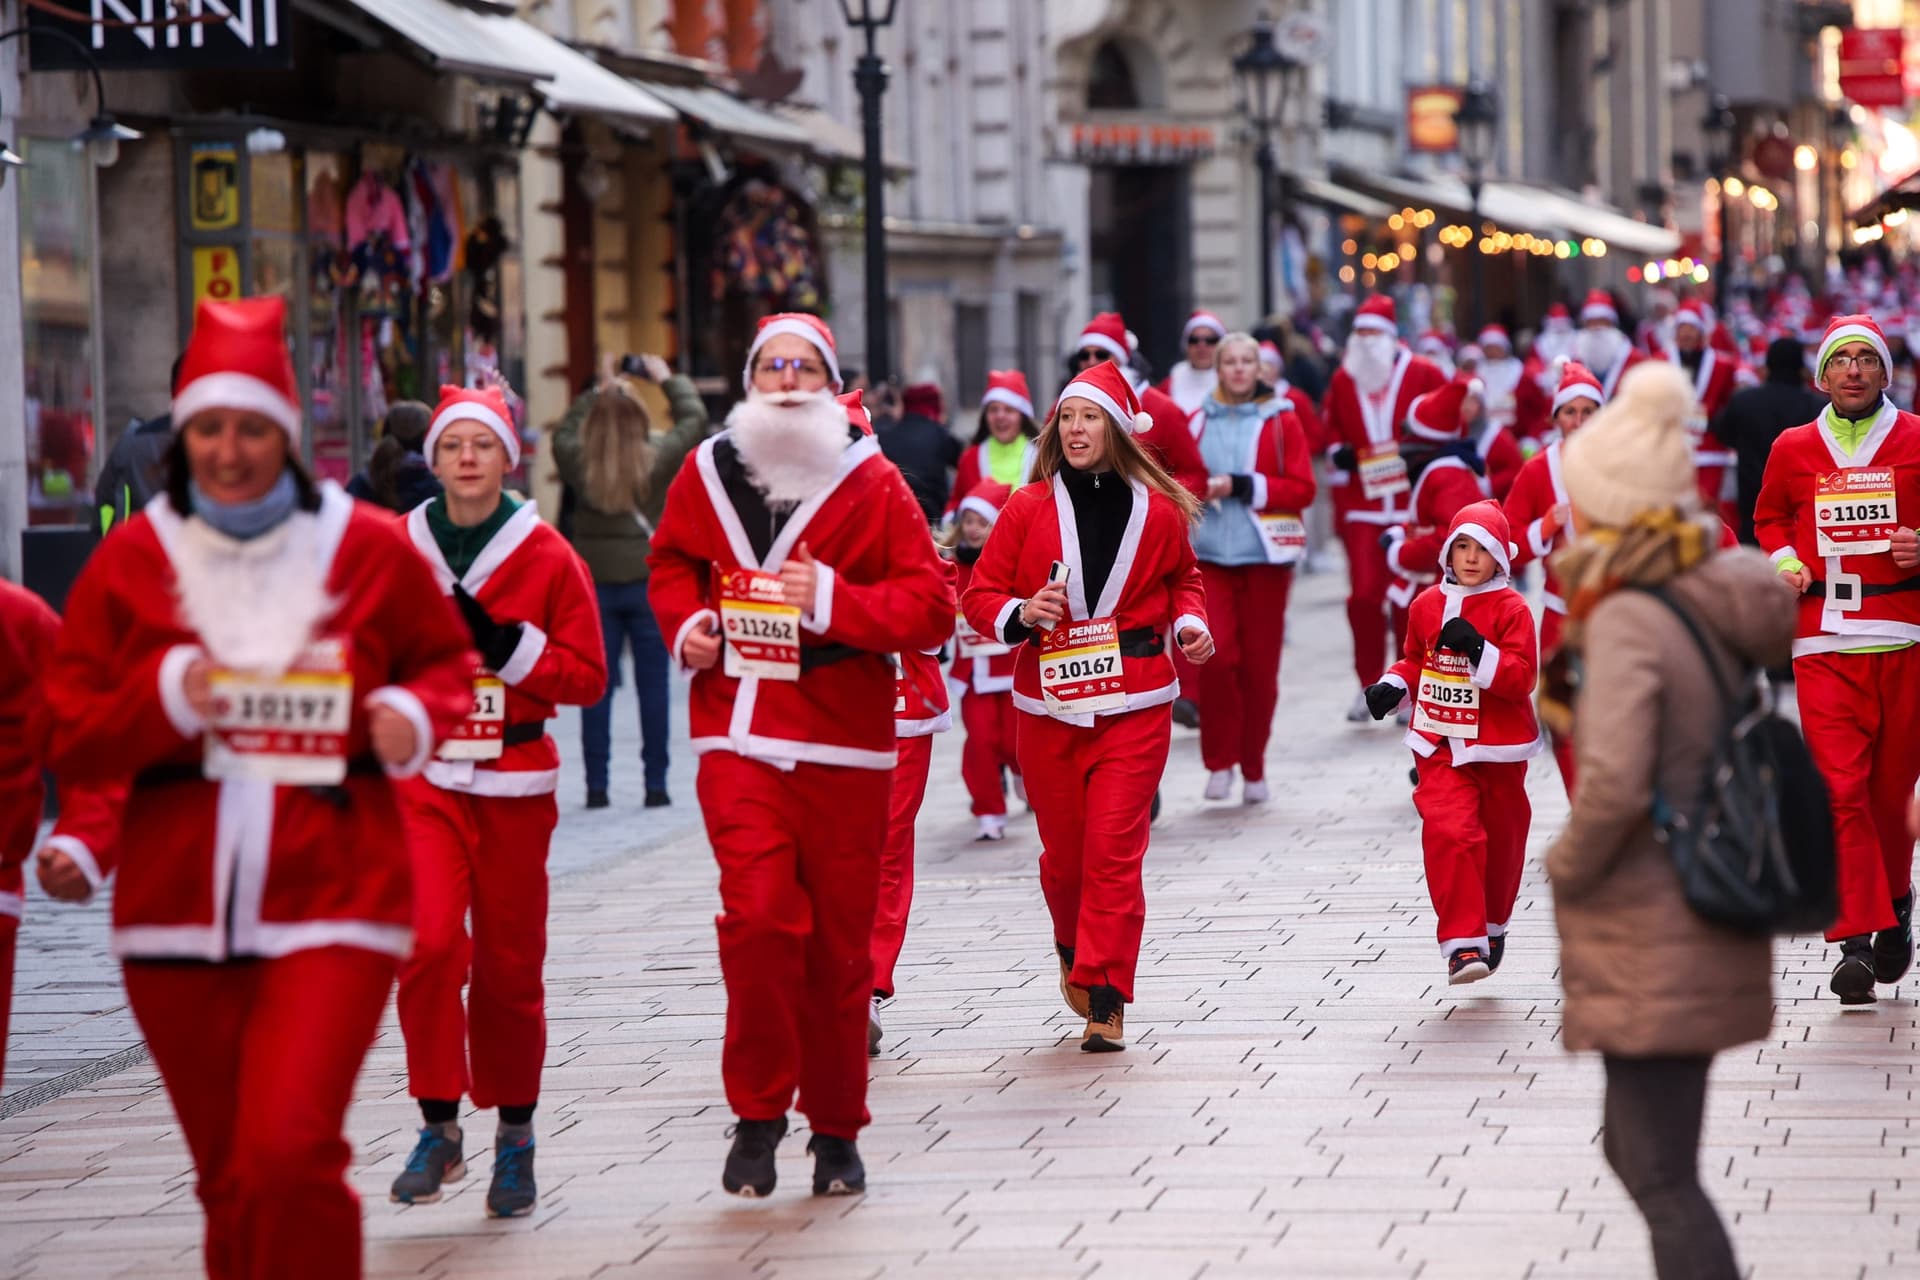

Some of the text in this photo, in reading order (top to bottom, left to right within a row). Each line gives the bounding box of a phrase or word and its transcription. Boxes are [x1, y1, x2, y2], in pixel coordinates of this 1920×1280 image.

[1834, 504, 1891, 522] 11031
[740, 618, 793, 640] 11262
[1058, 656, 1115, 680] 10167
[1431, 684, 1473, 704] 11033
[241, 694, 336, 722] 10197
